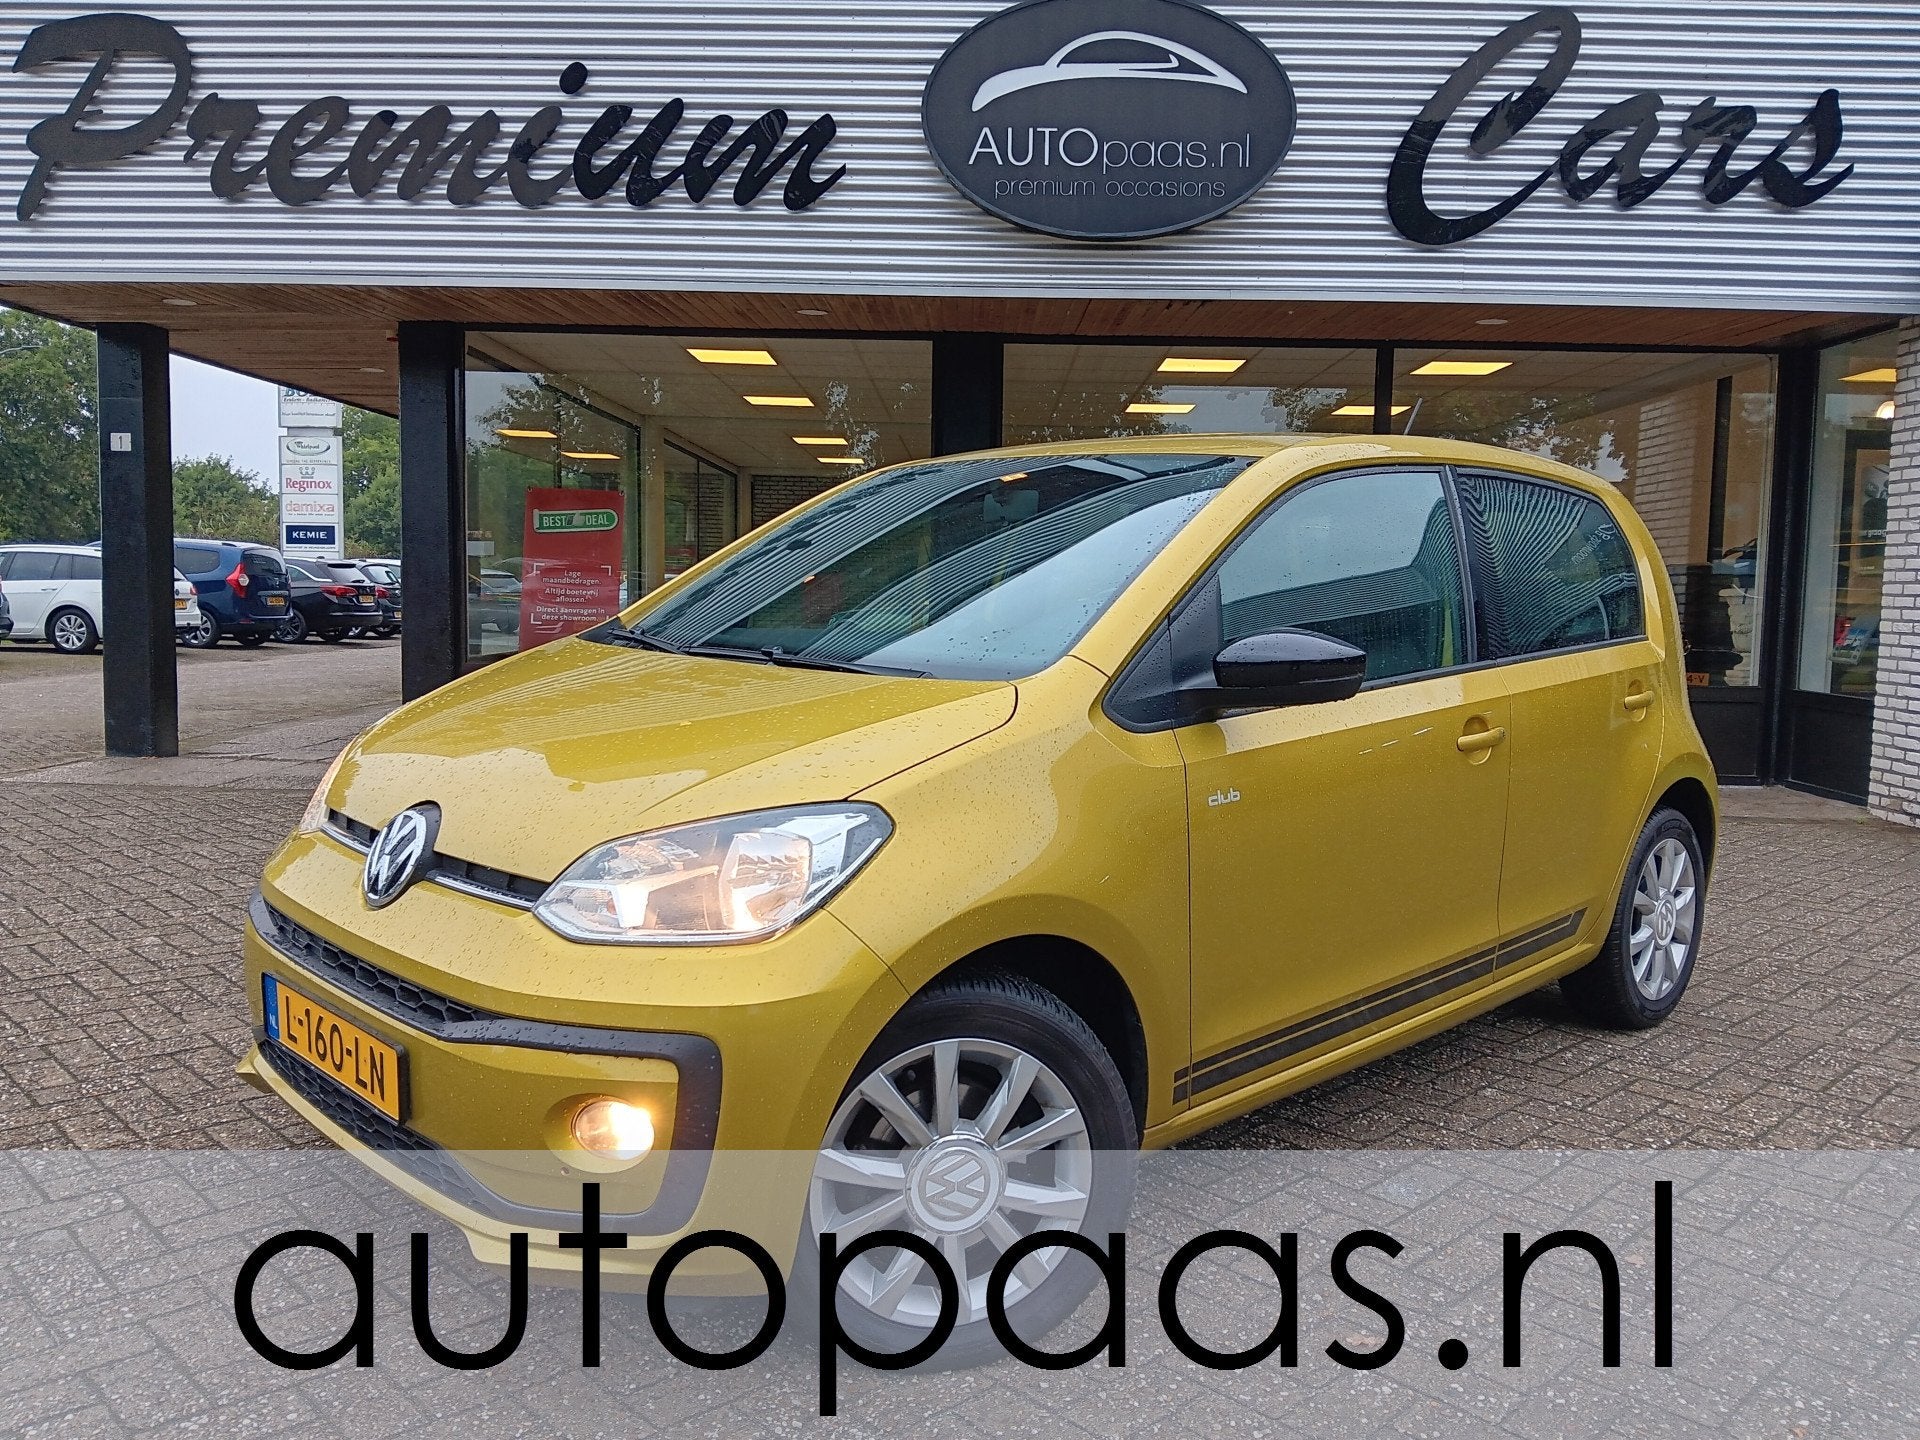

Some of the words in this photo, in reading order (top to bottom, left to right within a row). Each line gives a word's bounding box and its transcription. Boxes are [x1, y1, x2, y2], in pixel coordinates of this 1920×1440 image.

[12, 12, 847, 222] Premium
[1387, 5, 1854, 245] Cars
[968, 126, 1250, 174] AUTOpaas.nl
[994, 176, 1096, 200] premium
[1105, 176, 1226, 198] occasions
[118, 435, 123, 450] 1
[285, 477, 332, 493] Reginox
[285, 500, 335, 513] damixa
[543, 516, 567, 527] BEST
[585, 514, 609, 526] DEAL
[292, 531, 328, 539] KEMIE
[542, 577, 602, 586] maandbedragen.
[564, 570, 581, 578] Lage
[545, 587, 566, 596] Altijd
[536, 605, 559, 613] Direct
[560, 607, 597, 615] aanvragen
[1208, 787, 1241, 807] club
[269, 1013, 279, 1030] NL
[285, 994, 385, 1102] L-160-LN
